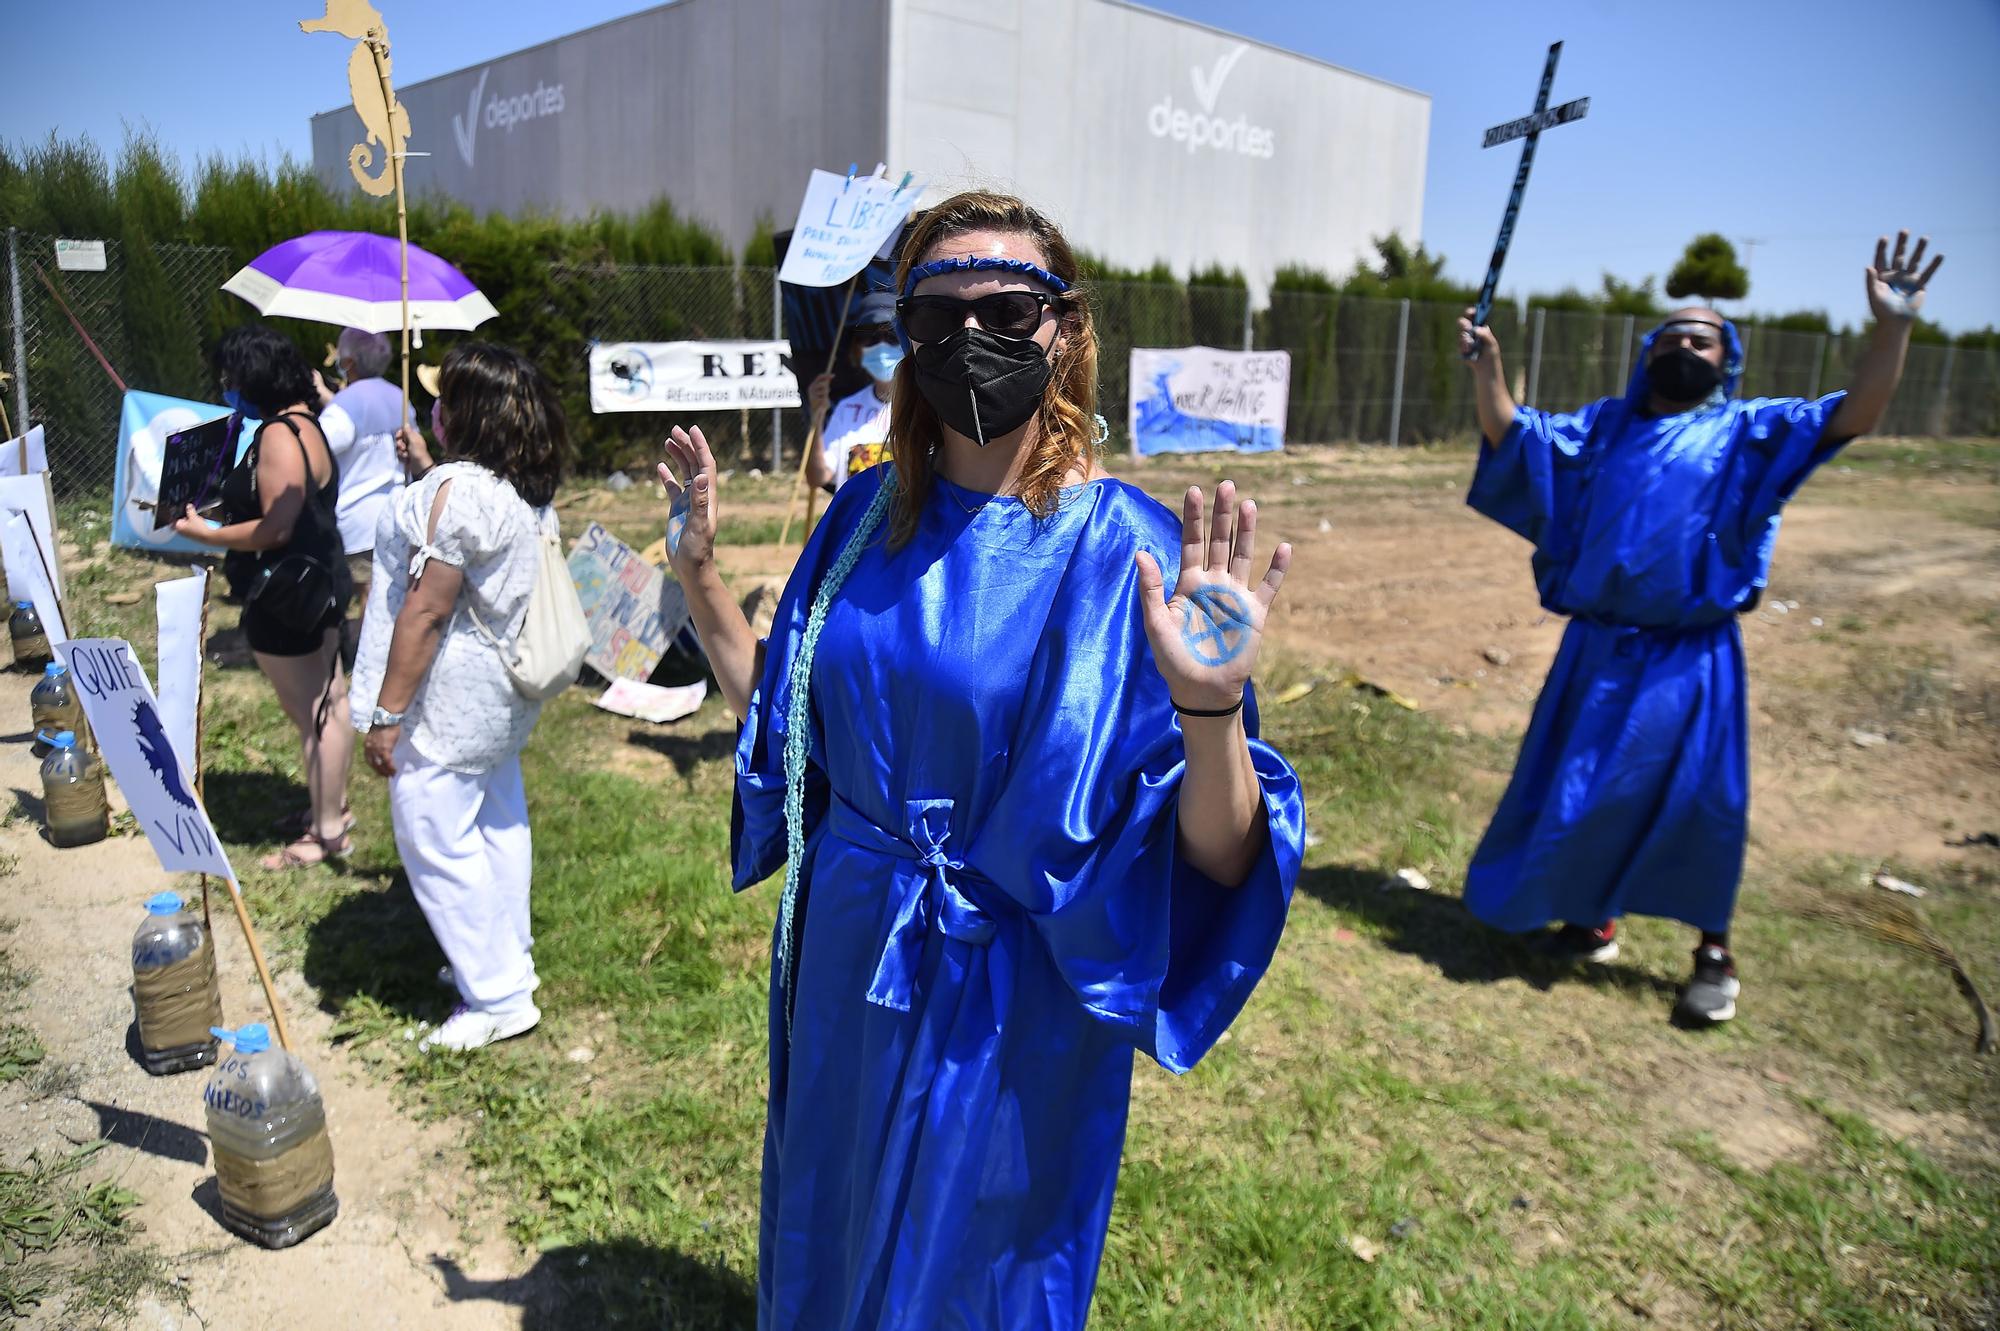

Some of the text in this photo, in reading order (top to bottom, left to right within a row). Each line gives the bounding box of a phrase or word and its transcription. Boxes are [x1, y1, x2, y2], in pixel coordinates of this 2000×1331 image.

[484, 80, 565, 134] deportes
[1148, 94, 1275, 158] deportes
[1241, 357, 1285, 383] SEAS
